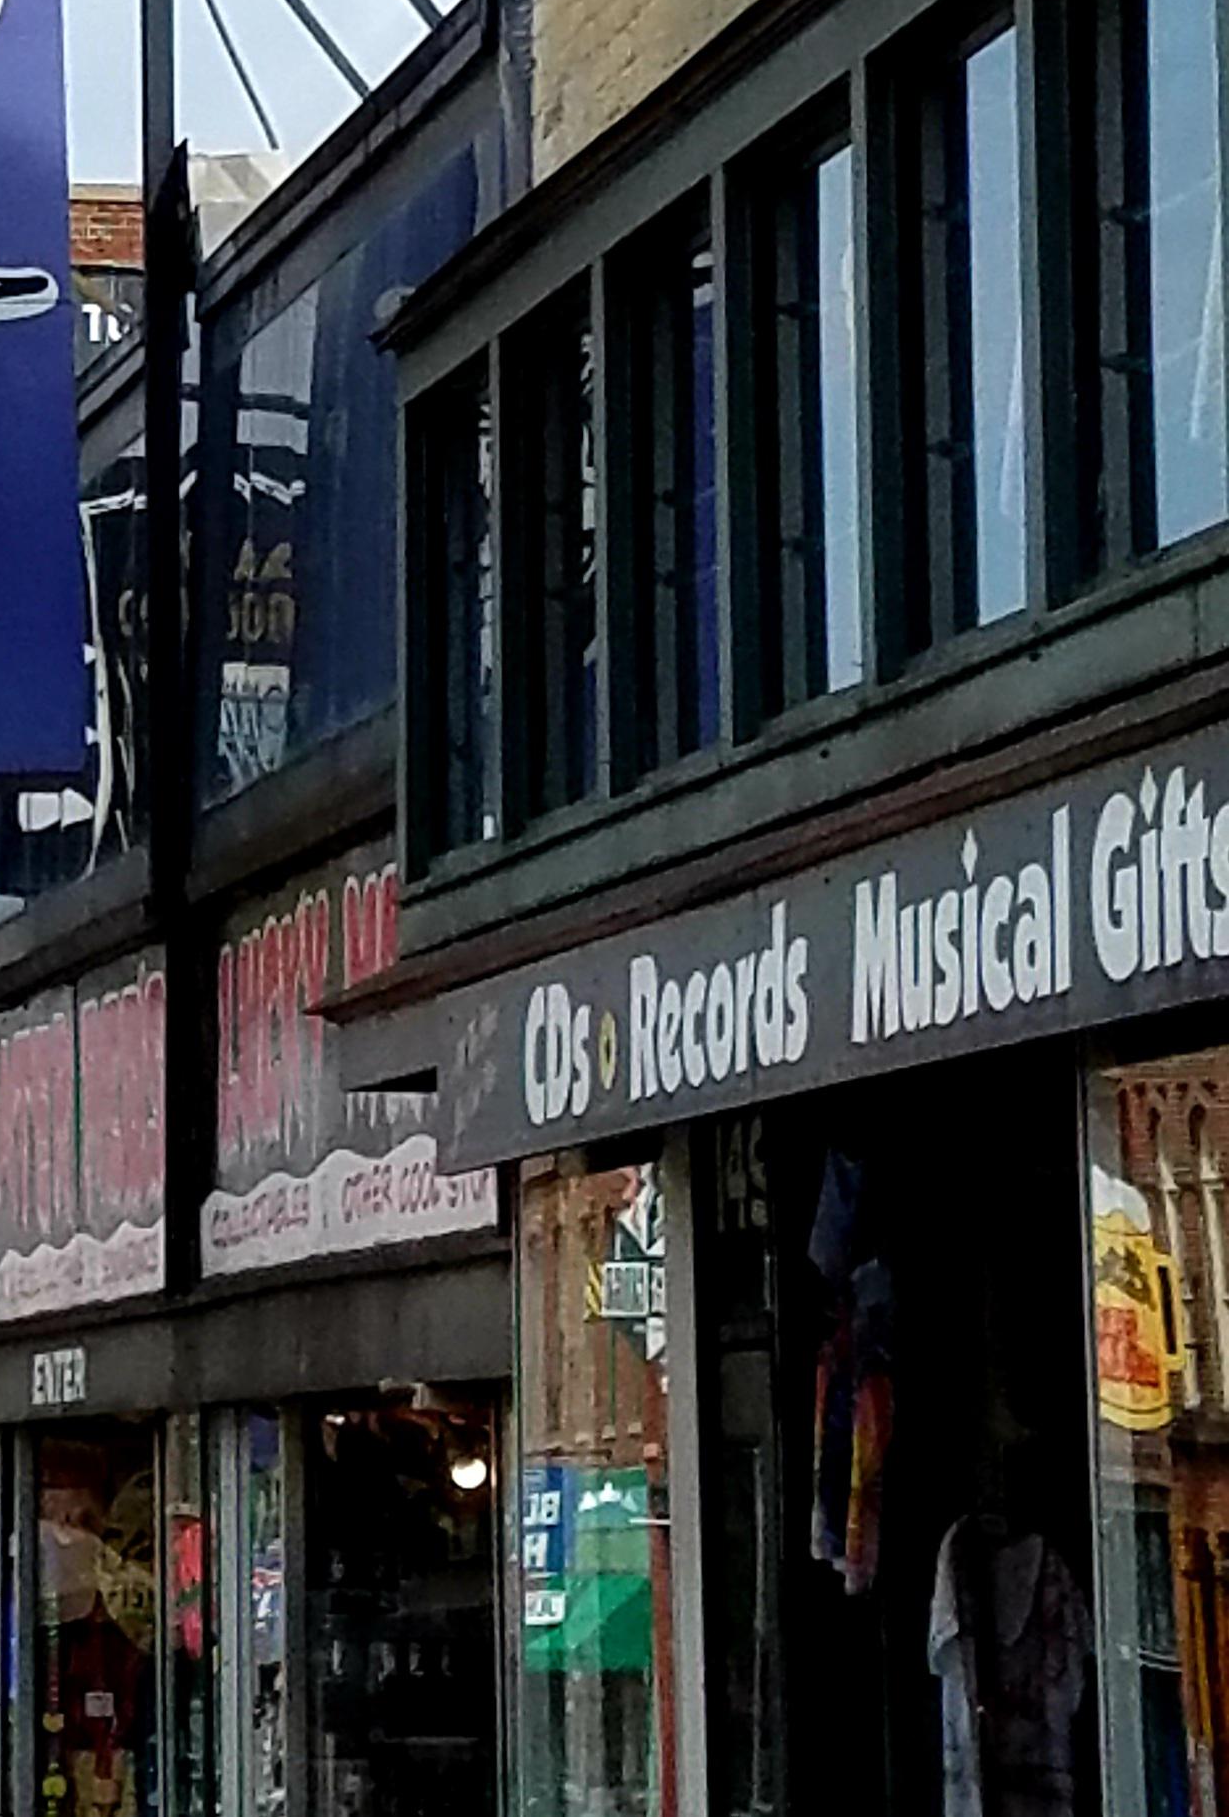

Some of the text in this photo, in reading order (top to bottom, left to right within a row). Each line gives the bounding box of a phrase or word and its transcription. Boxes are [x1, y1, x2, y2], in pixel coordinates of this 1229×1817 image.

[523, 982, 592, 1126] CDs
[628, 900, 809, 1104] Records
[850, 802, 1072, 1046] Musical
[32, 1347, 86, 1405] ENTER
